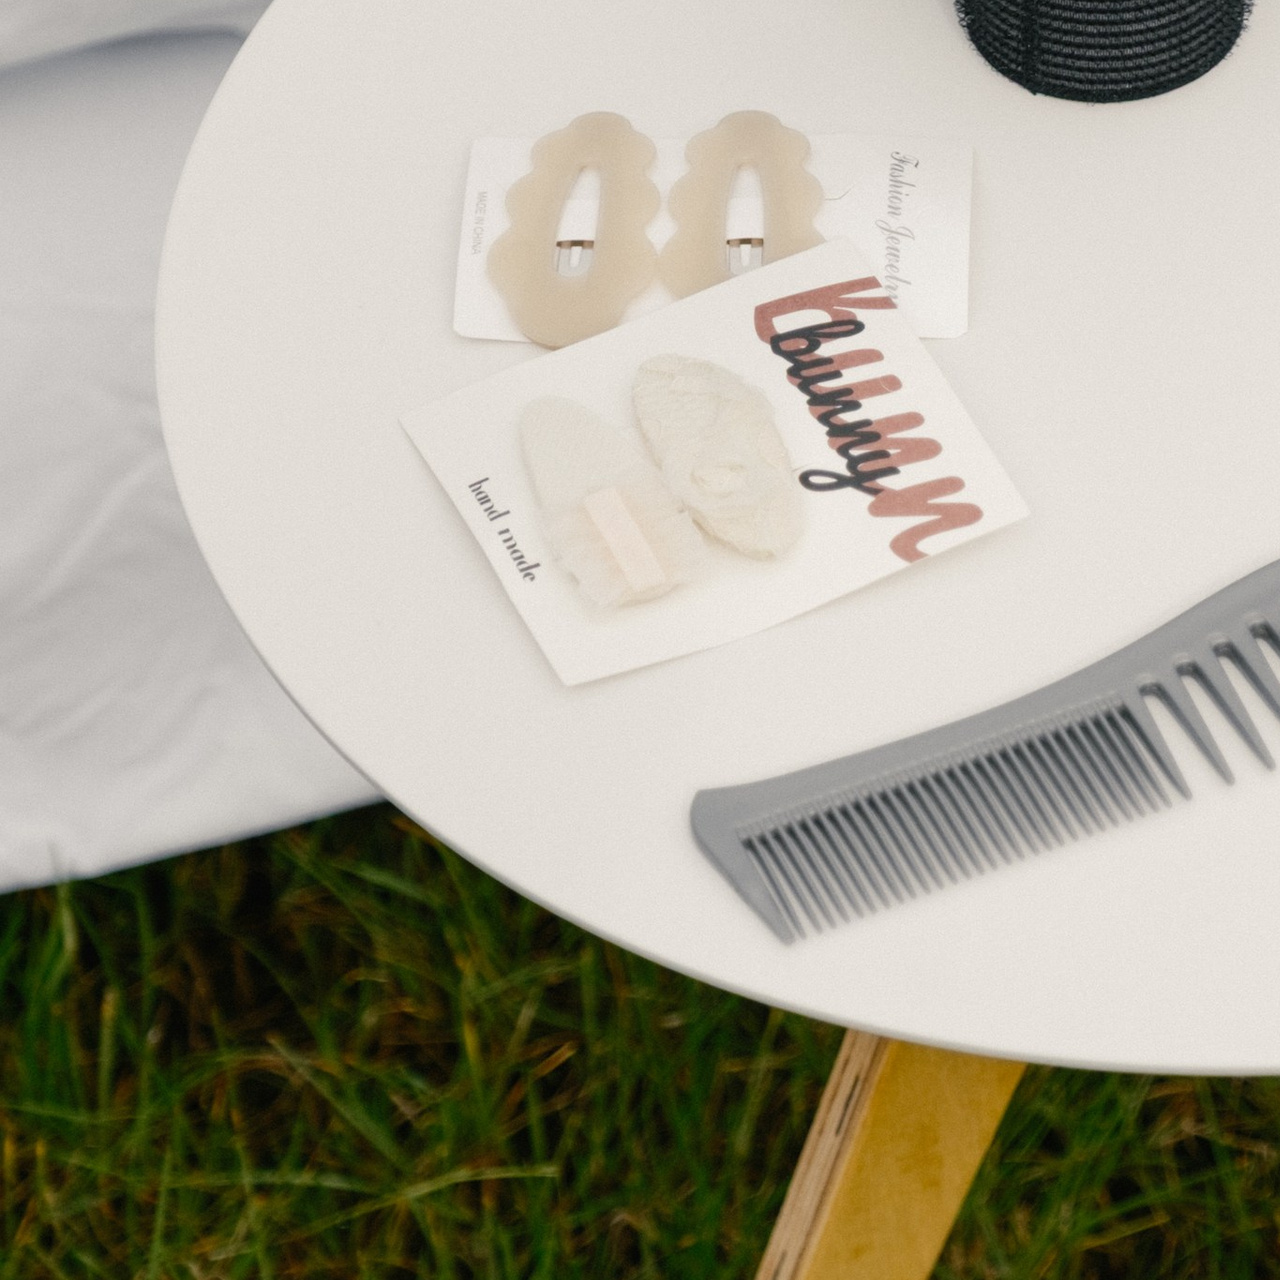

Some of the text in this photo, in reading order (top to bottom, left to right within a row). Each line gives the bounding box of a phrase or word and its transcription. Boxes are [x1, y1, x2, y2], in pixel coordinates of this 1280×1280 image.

[472, 191, 488, 255] MADE IN CHINA
[888, 151, 919, 216] Fashion
[770, 319, 901, 496] bunny
[468, 477, 541, 582] hand made
